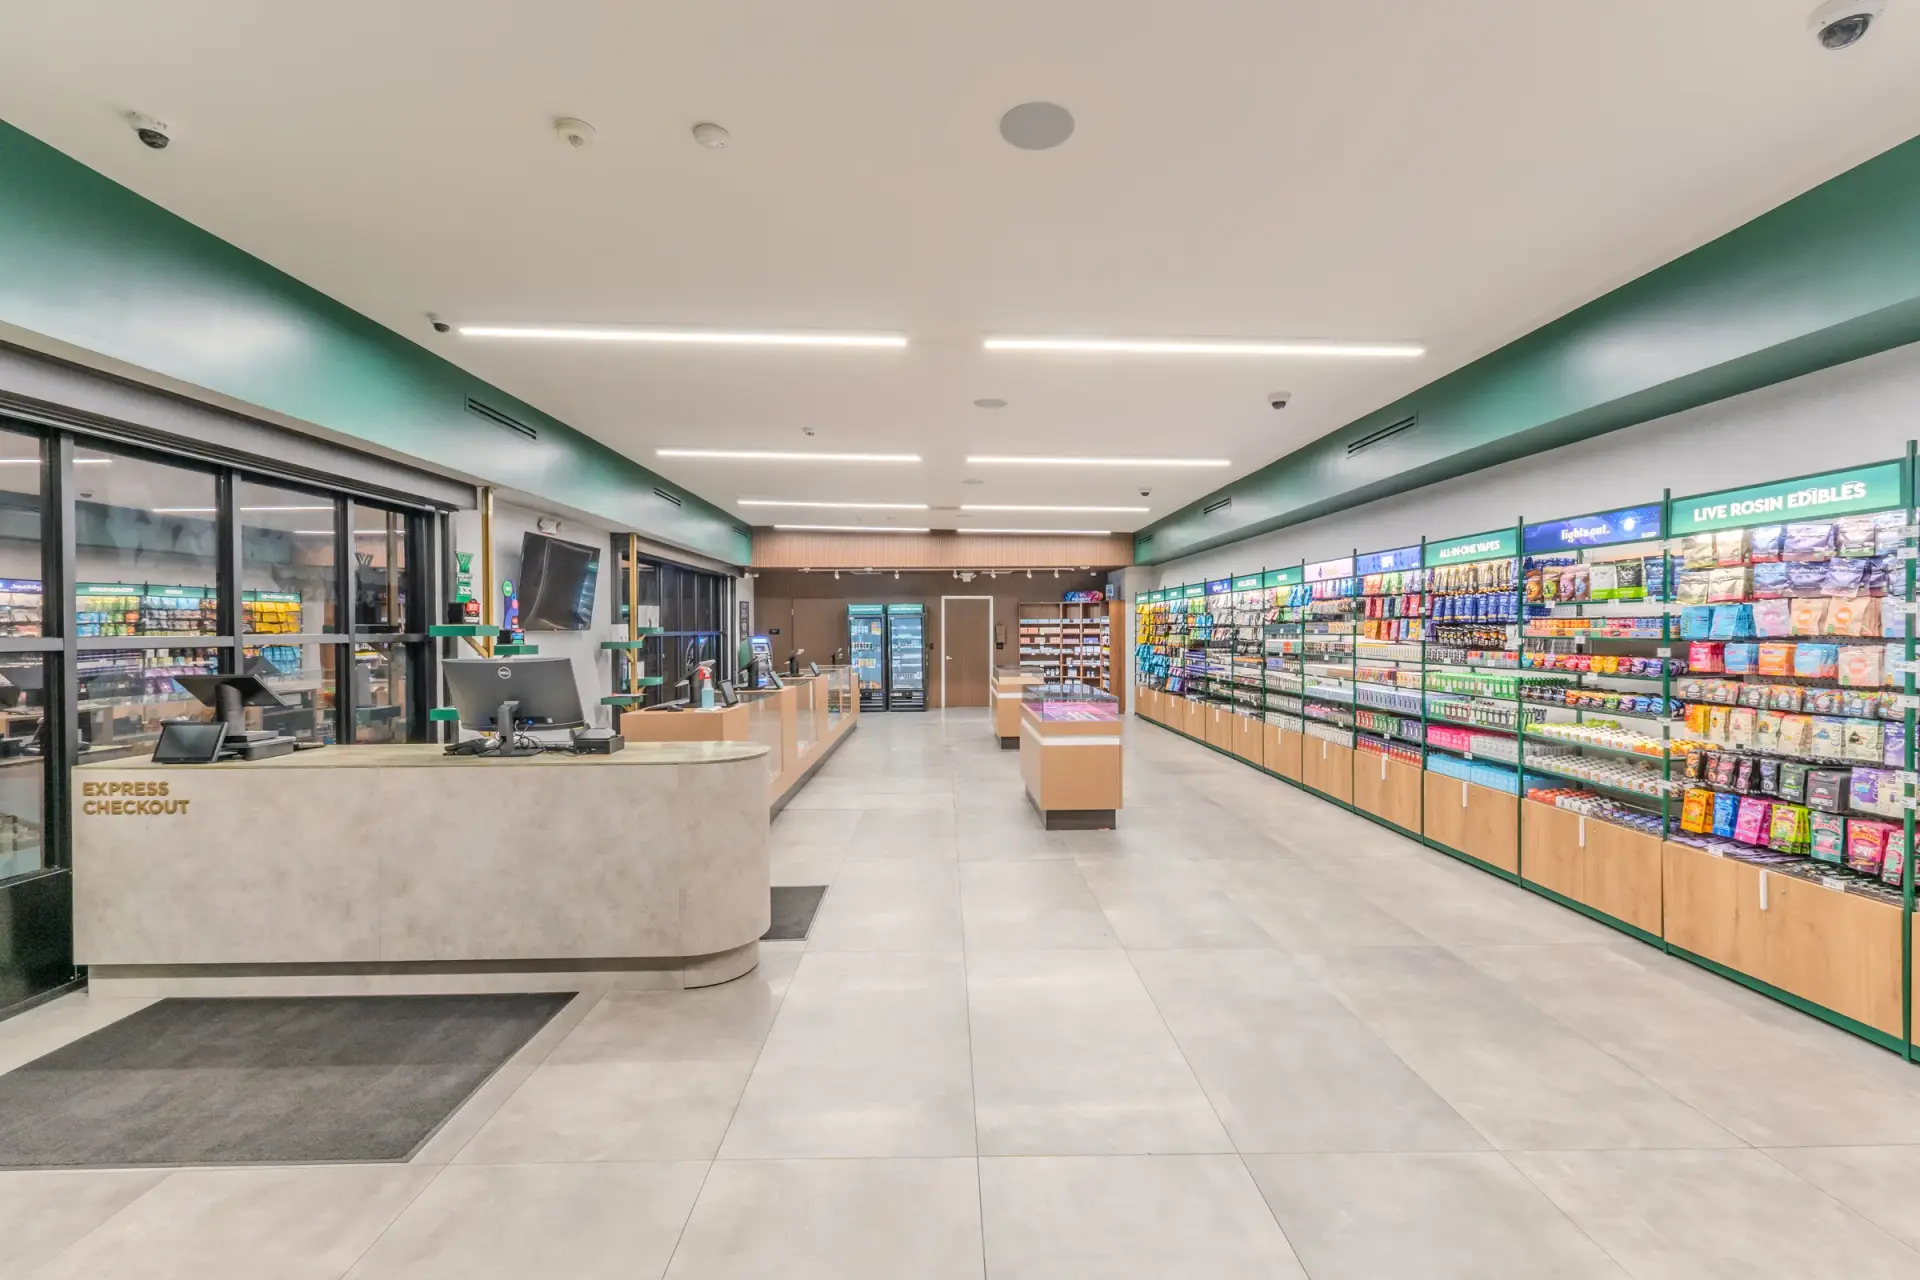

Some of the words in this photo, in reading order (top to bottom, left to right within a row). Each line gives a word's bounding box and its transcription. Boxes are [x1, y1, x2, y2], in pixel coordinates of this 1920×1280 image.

[1693, 505, 1727, 523] LIVE
[1730, 495, 1783, 517] ROSIN
[1787, 481, 1867, 509] EDIBLES
[1561, 526, 1590, 543] lights
[1439, 543, 1477, 558] ALL-IN-ONE
[1477, 540, 1500, 553] VAPES
[82, 781, 169, 797] EXPRESS
[82, 799, 190, 815] CHECKOUT
